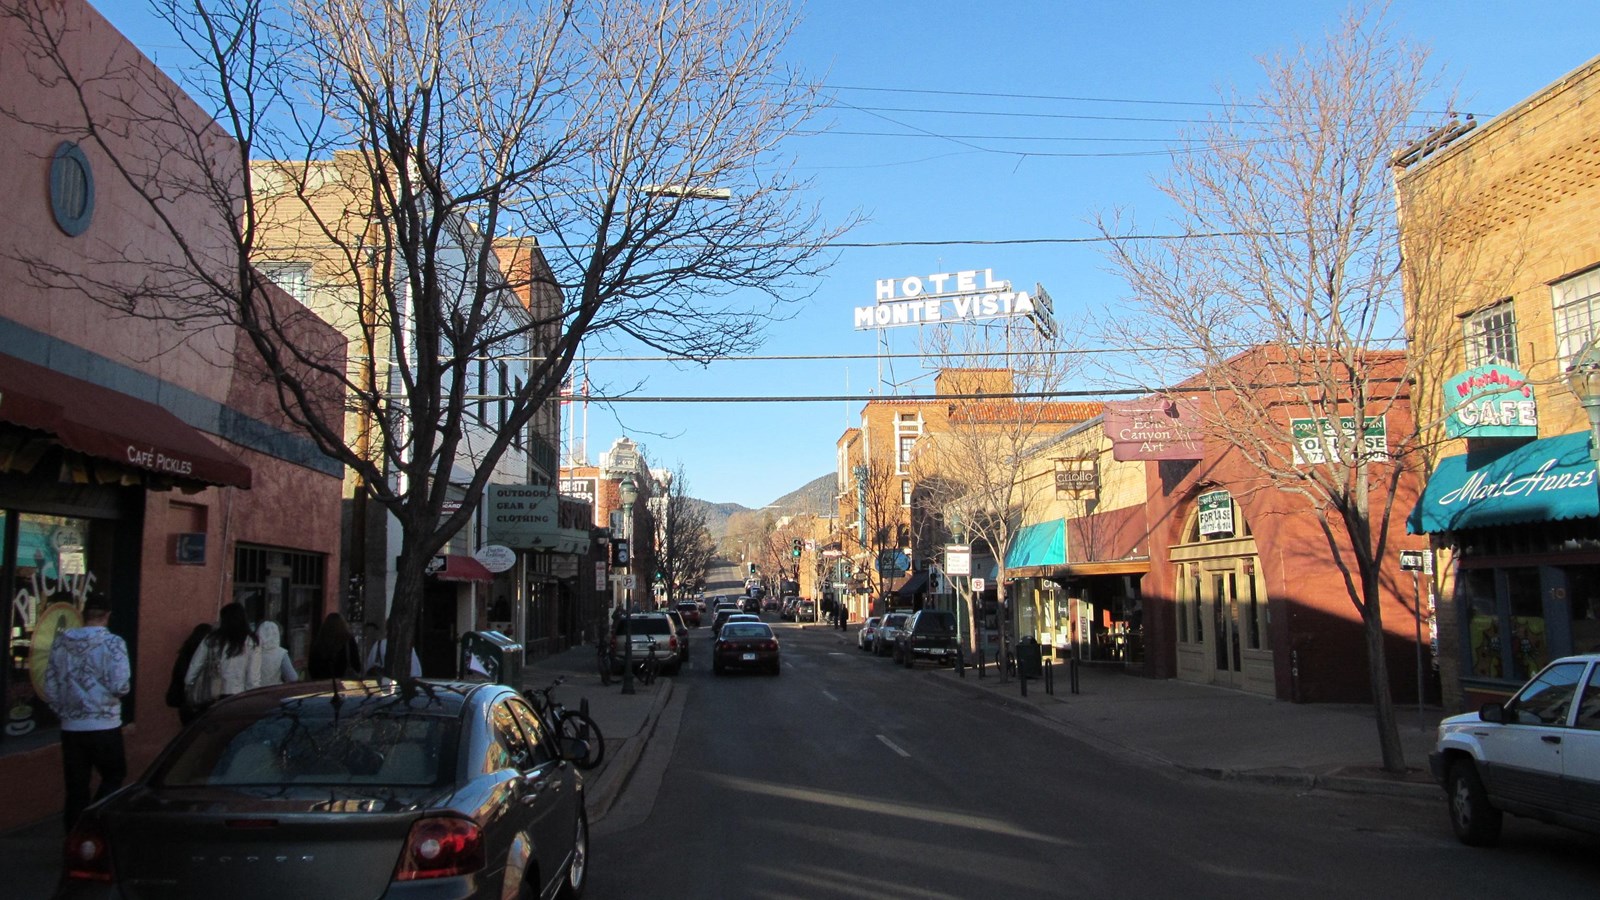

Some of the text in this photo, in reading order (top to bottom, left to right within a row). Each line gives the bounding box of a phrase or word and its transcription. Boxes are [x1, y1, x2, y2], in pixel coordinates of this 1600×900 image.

[876, 268, 1004, 301] HOTEL
[854, 300, 941, 327] MONTE
[952, 291, 1034, 318] VISTA
[1457, 399, 1537, 426] CAFE
[1119, 428, 1171, 444] Canyon
[1139, 441, 1164, 453] Art
[127, 446, 192, 475] CAFÉ PICKLES
[497, 514, 549, 523] CLOTHING
[1200, 512, 1213, 523] FOR
